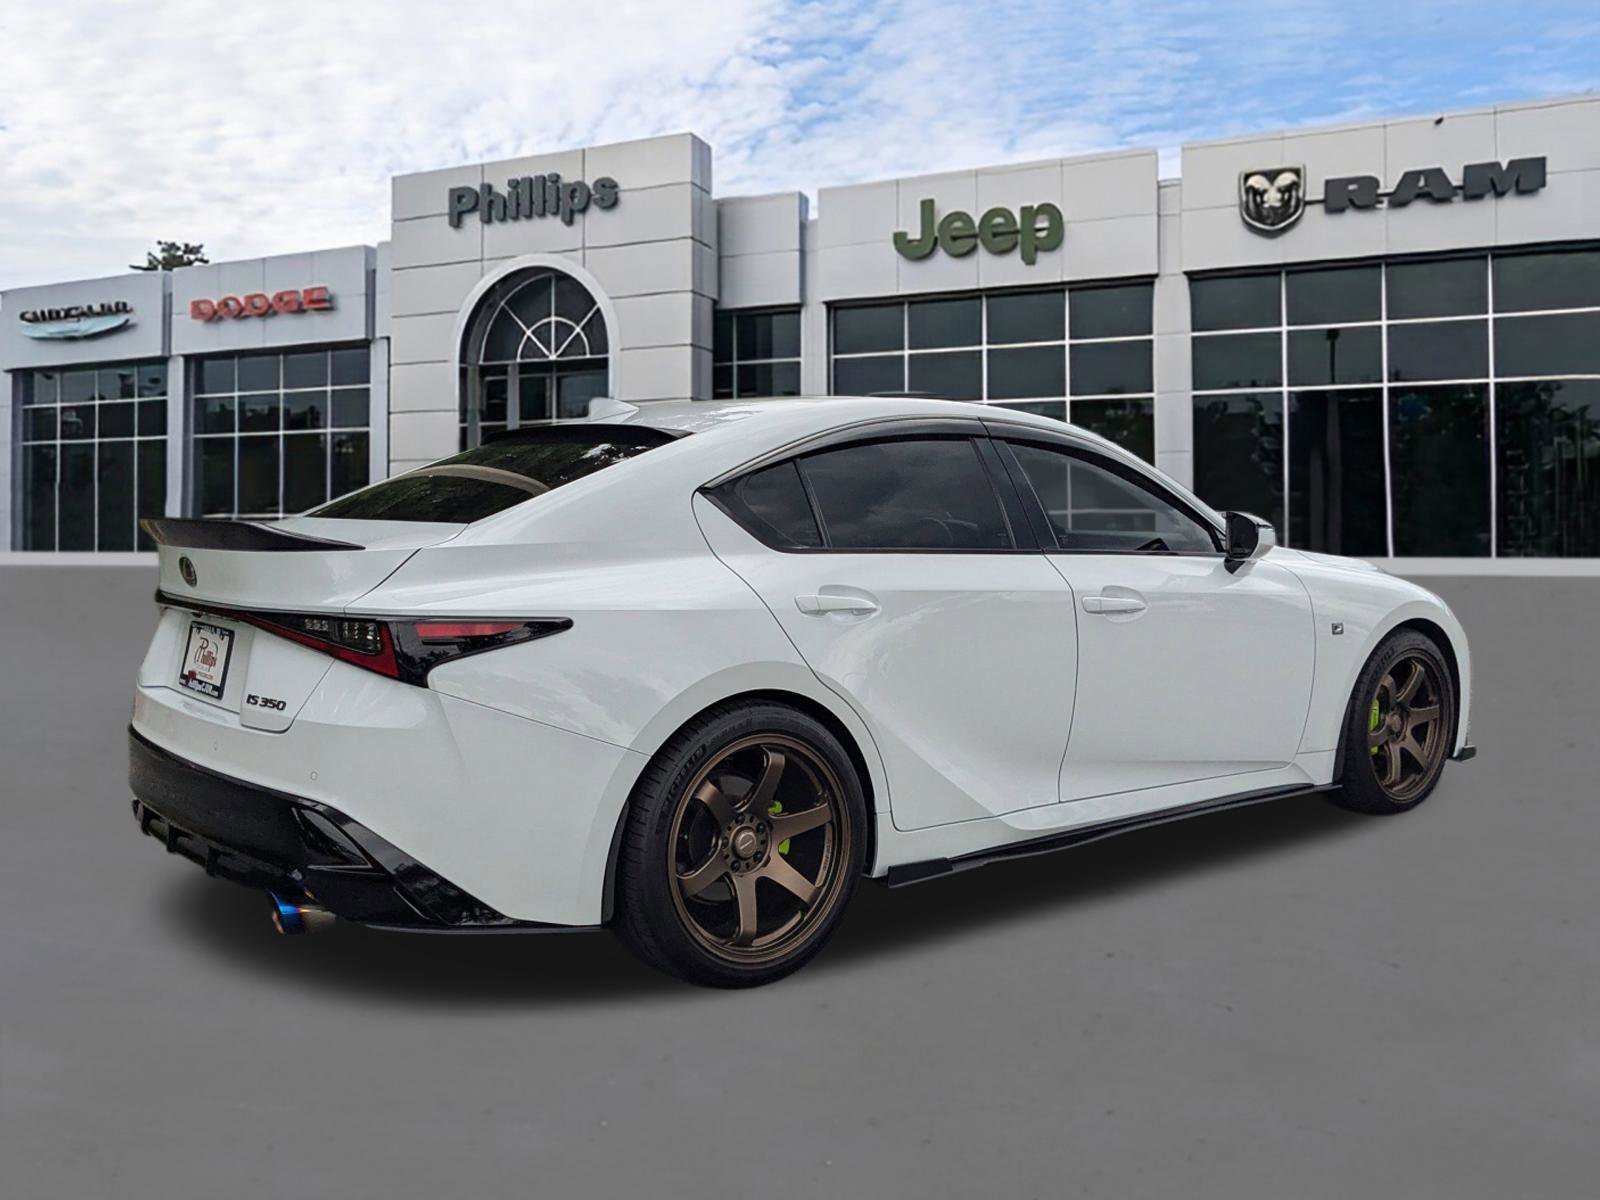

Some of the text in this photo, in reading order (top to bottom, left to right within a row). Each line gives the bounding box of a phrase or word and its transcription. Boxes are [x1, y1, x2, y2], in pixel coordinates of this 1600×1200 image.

[448, 173, 619, 228] Phillips
[1324, 156, 1547, 214] RAM
[893, 198, 1065, 265] Jeep
[190, 286, 330, 321] DODGE
[259, 697, 287, 711] 350
